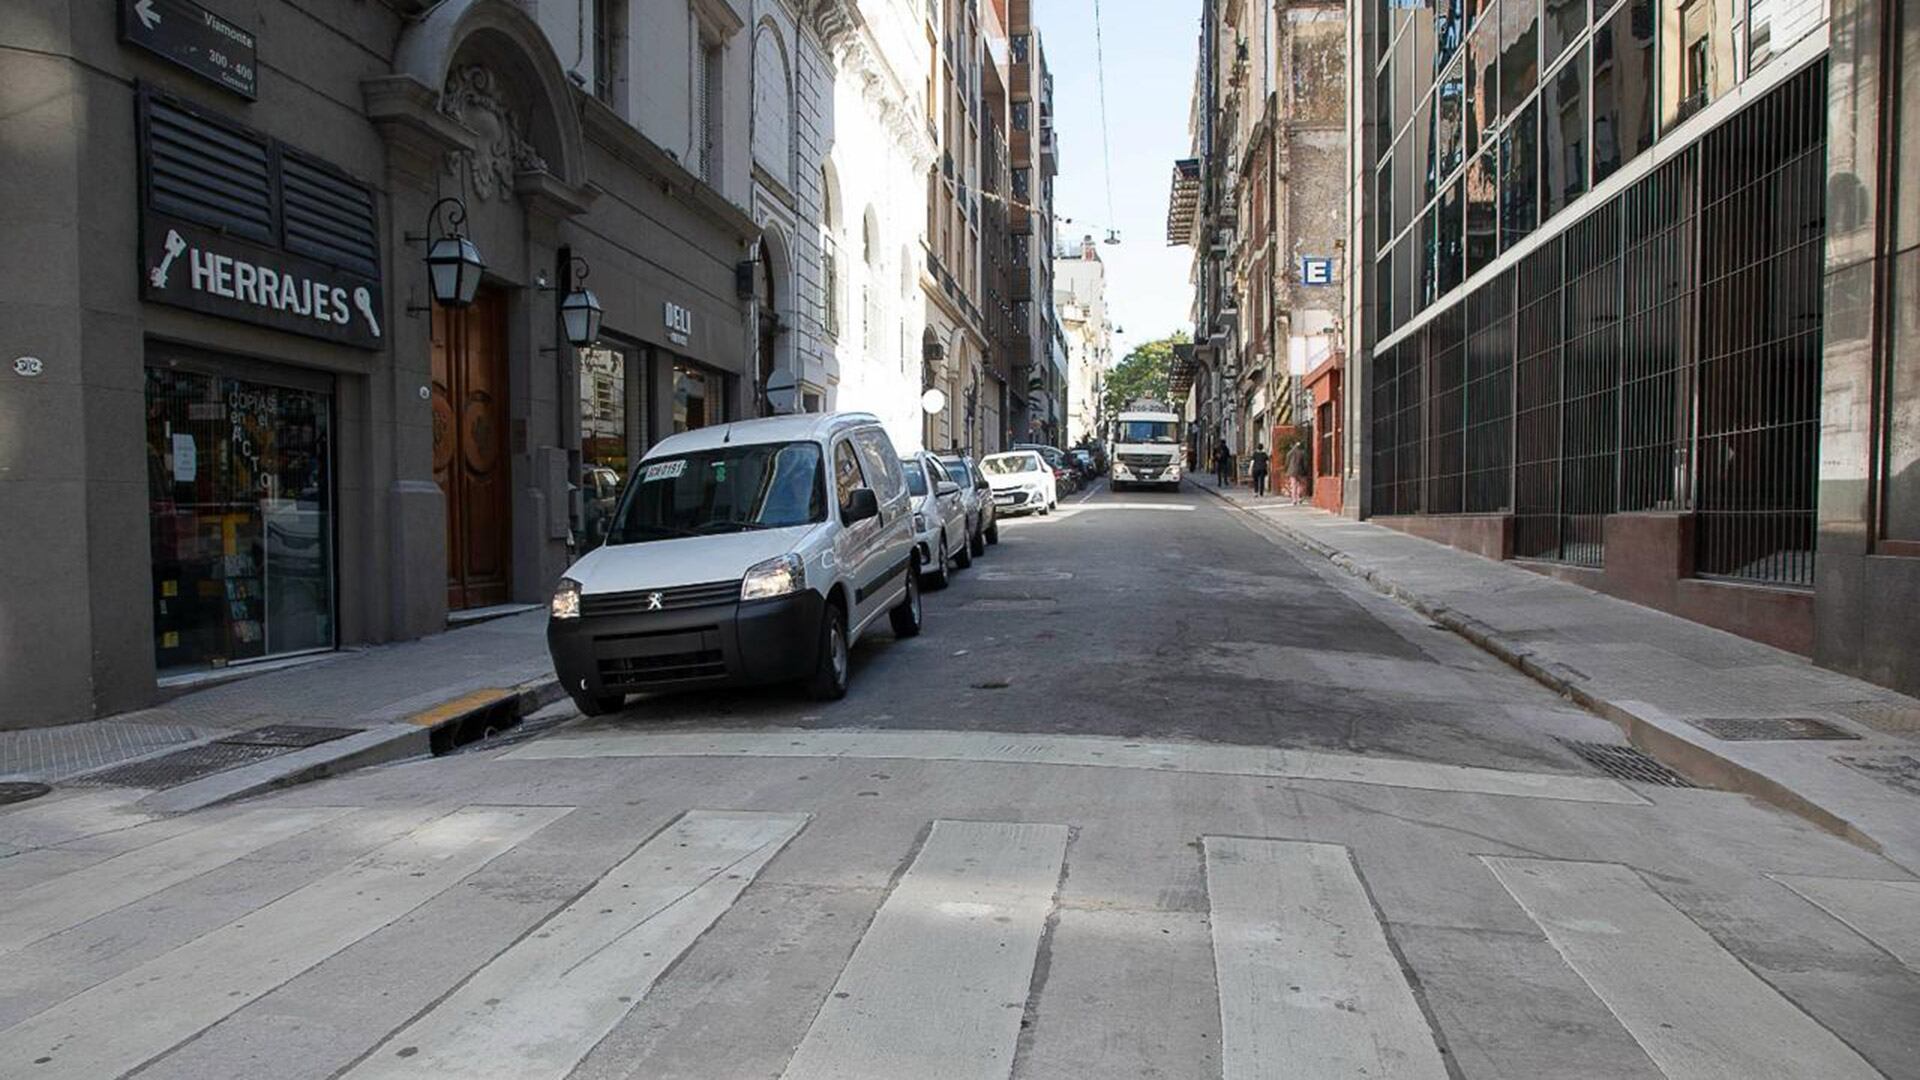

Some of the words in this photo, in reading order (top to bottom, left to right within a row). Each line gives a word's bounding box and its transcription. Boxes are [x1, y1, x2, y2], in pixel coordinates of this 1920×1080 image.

[203, 11, 254, 49] Viamonte
[208, 48, 228, 69] 300
[235, 62, 253, 81] 400
[190, 248, 350, 325] HERRAJES
[1307, 262, 1327, 283] E
[664, 301, 692, 336] DELI
